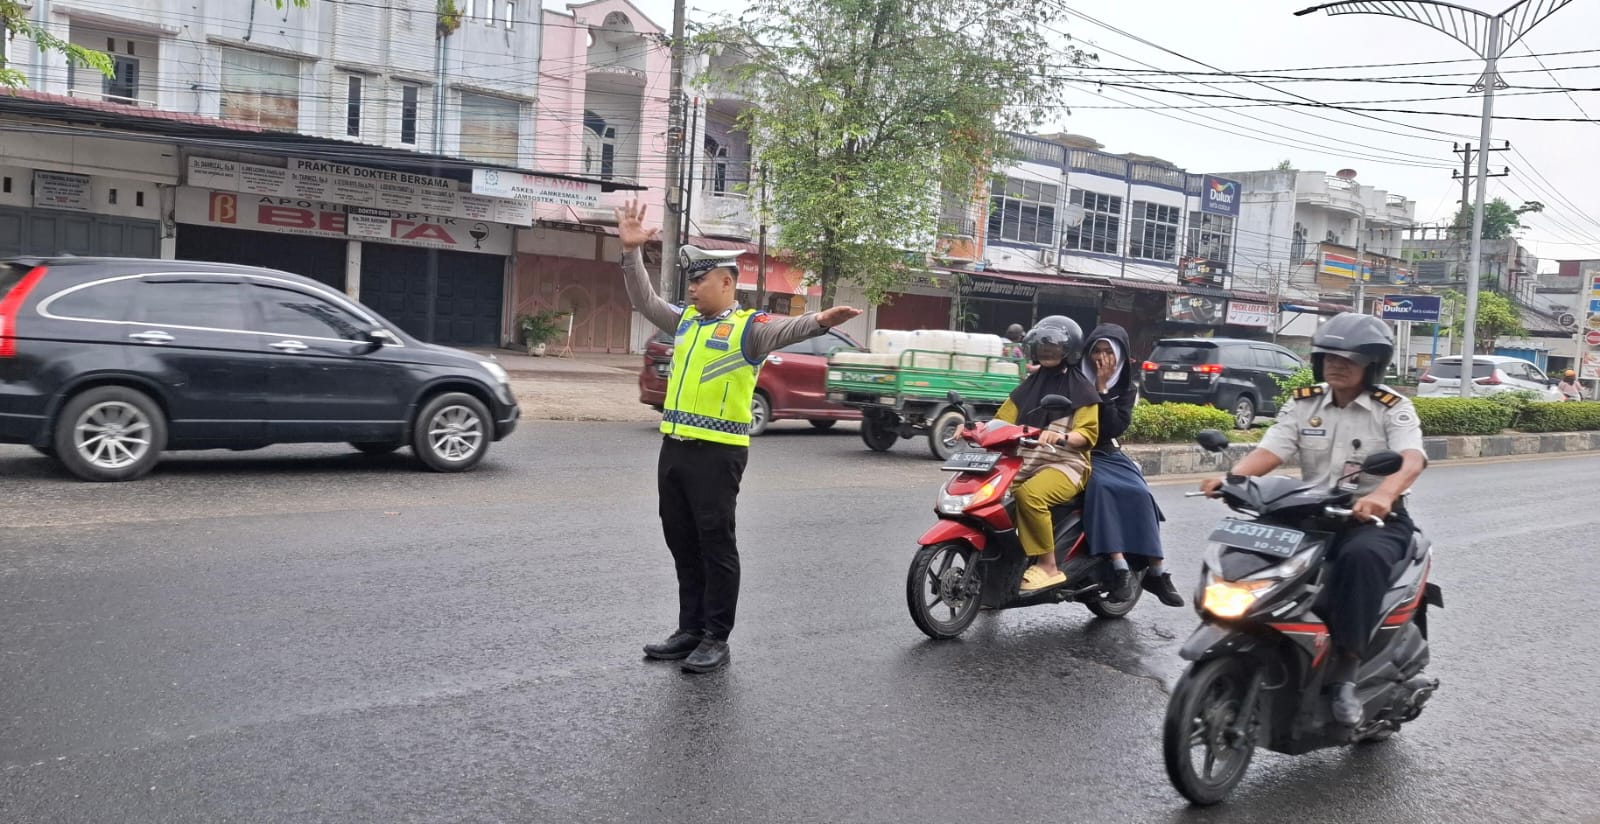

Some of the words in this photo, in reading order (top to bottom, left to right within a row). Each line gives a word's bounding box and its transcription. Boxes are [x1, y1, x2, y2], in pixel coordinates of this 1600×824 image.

[297, 160, 351, 175] PRAKTEK
[353, 167, 397, 181] DOKTER
[400, 174, 449, 188] BERSAMA
[522, 174, 589, 192] MELAYANI
[511, 186, 534, 194] ASKES
[539, 189, 580, 200] JAMKESMAS
[513, 193, 554, 204] JAMSOSTEK
[1210, 188, 1232, 203] Dulux
[259, 196, 348, 212] APOTI
[1384, 304, 1409, 313] Dulux
